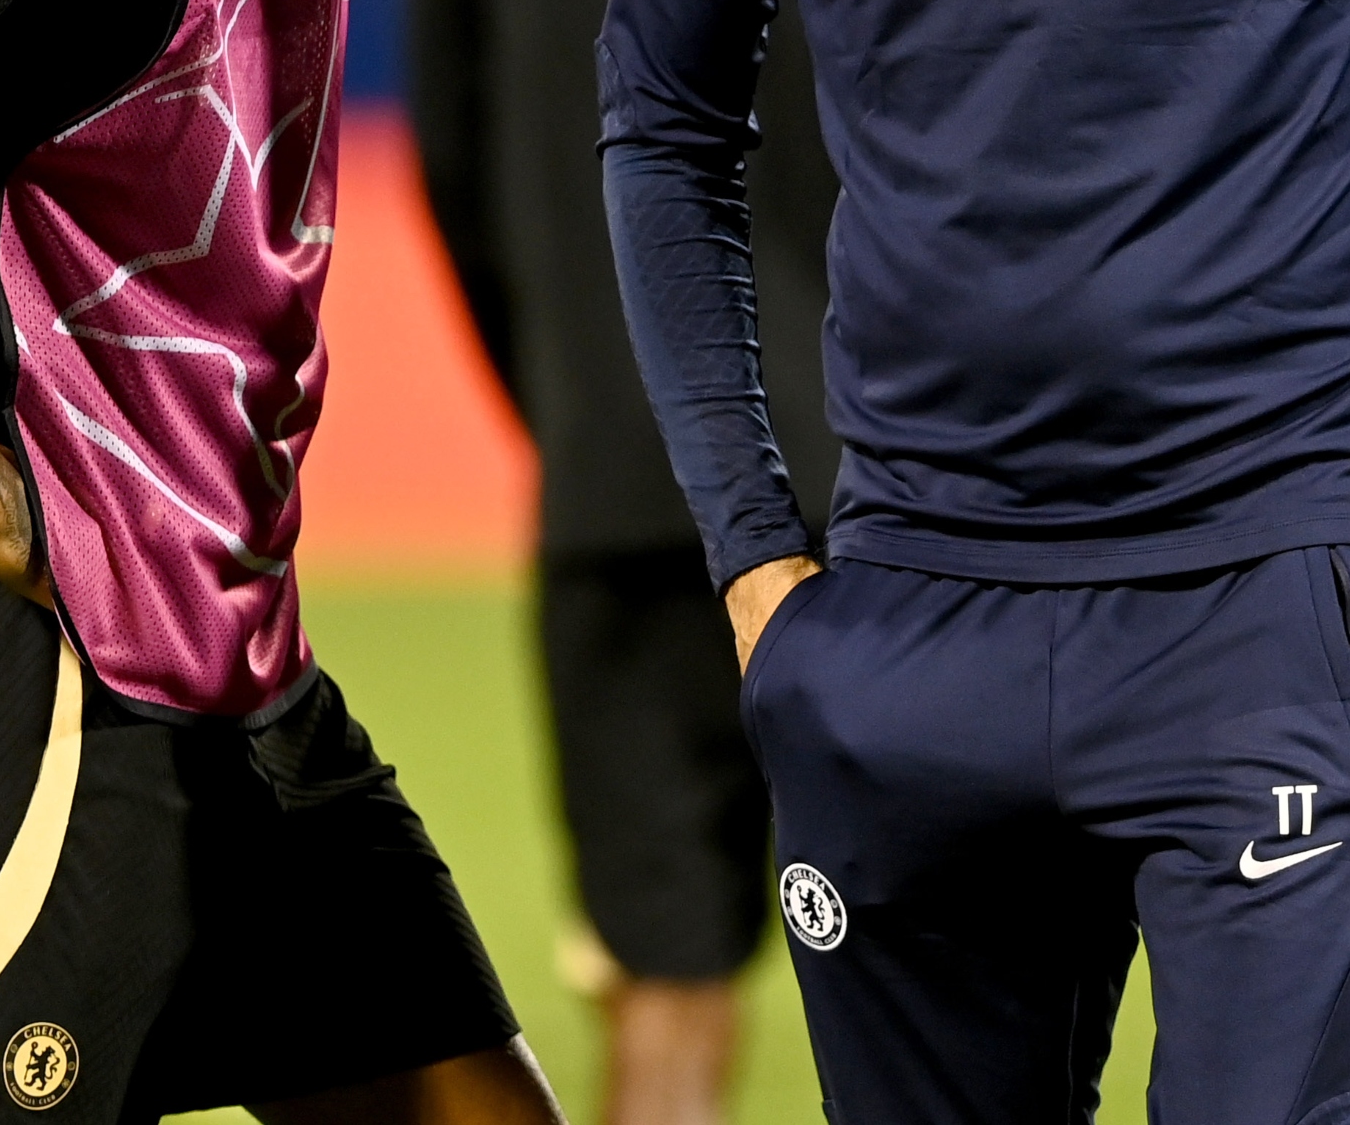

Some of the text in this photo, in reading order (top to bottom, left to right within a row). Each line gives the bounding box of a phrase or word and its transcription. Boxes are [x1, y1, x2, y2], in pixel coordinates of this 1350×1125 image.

[1272, 785, 1318, 835] TT
[788, 869, 826, 891] CHELSEA
[24, 1026, 71, 1052] CHELSEA
